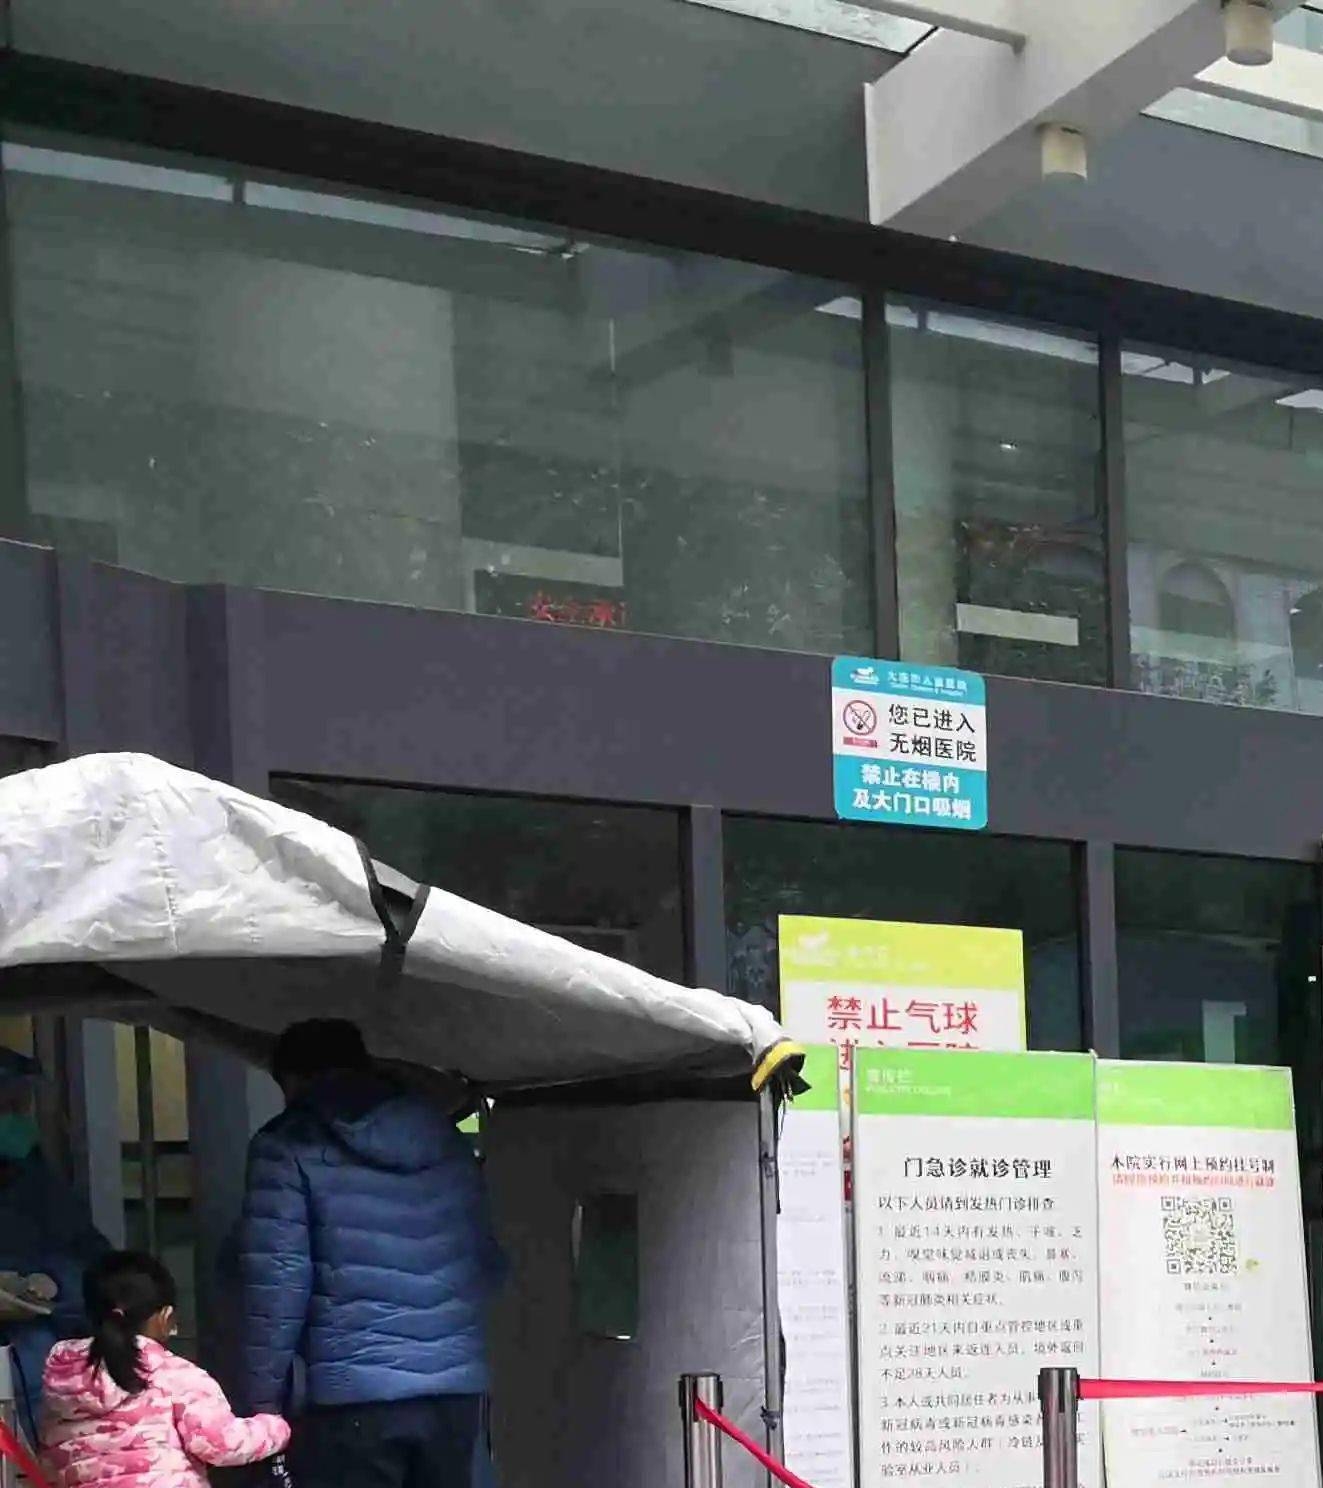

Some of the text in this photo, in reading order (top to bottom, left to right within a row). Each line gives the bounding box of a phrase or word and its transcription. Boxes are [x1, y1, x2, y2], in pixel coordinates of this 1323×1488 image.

[888, 703, 976, 734] 您已进入
[890, 732, 977, 762] 无烟医院
[861, 763, 961, 794] 禁止在楼内
[852, 788, 972, 820] 及大门口吸烟
[827, 995, 979, 1034] 禁止气球
[904, 1157, 1052, 1179] 门急诊就诊管理
